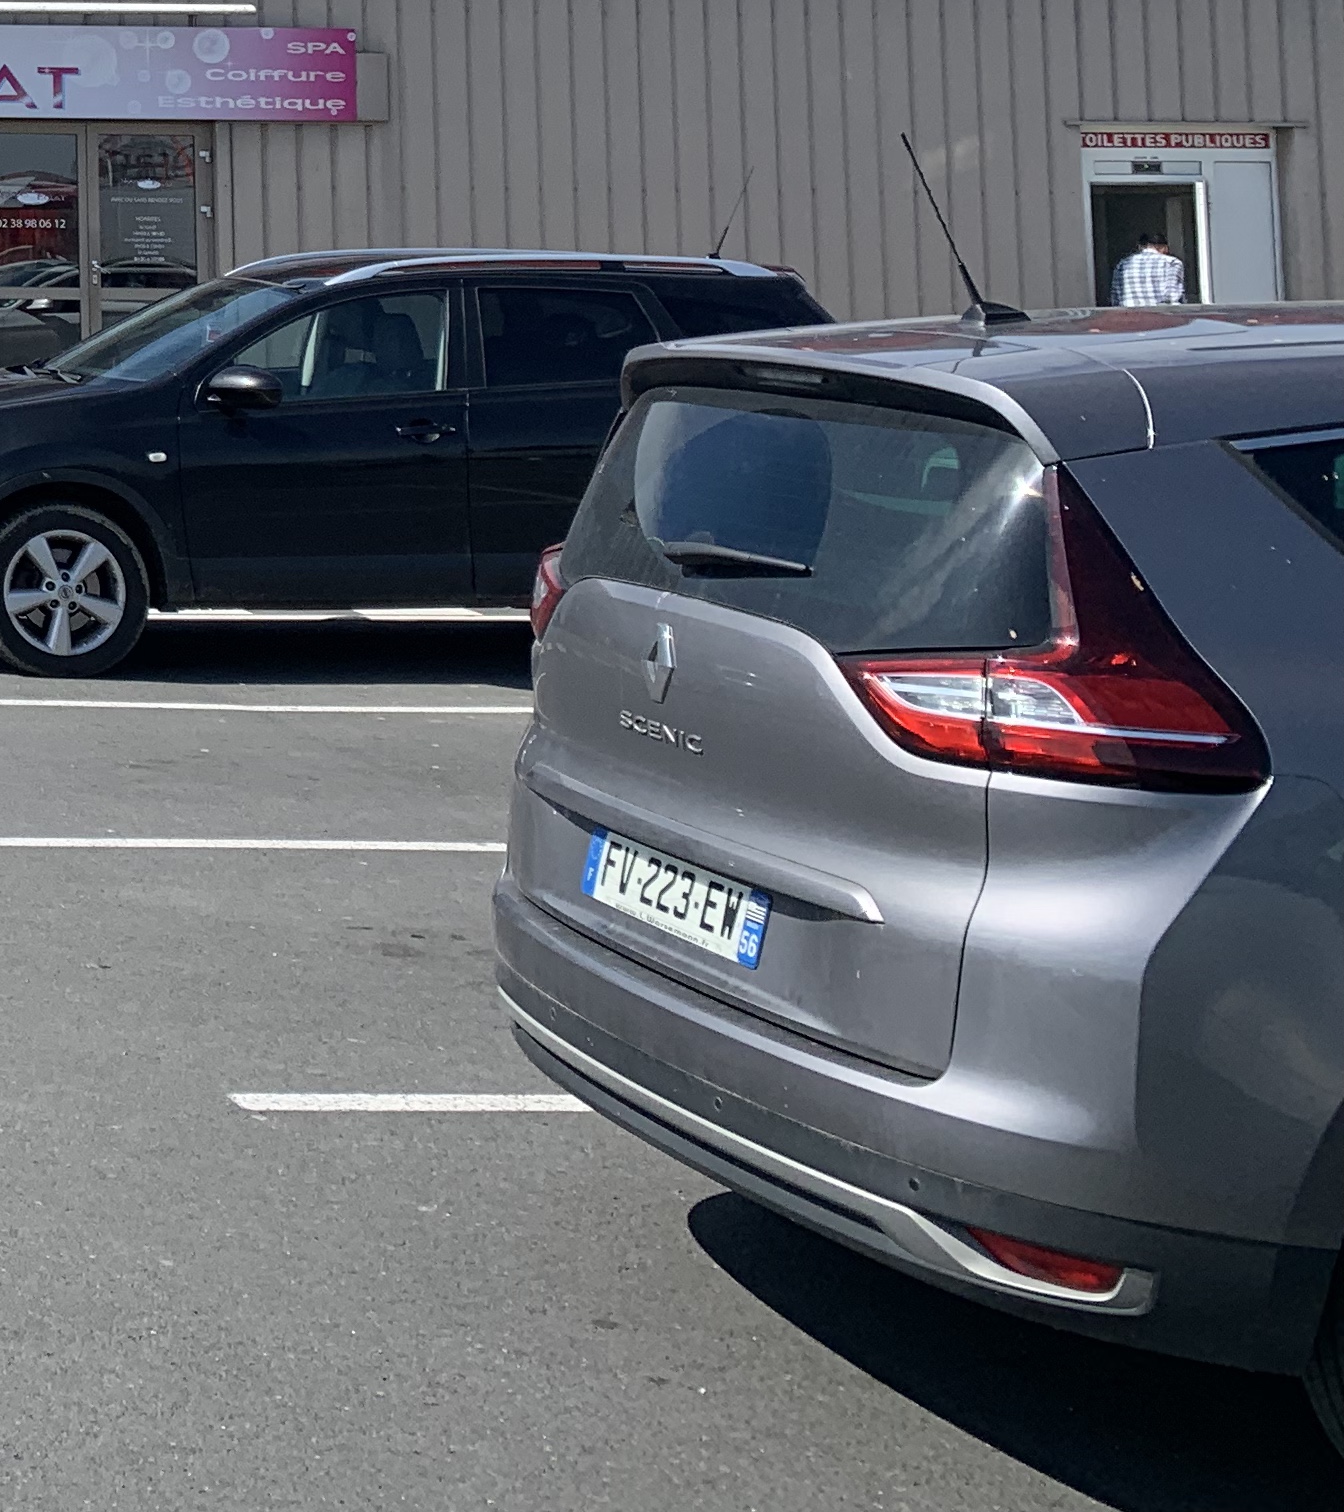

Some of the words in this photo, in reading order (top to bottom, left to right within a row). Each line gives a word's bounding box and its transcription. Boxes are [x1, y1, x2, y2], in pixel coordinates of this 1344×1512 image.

[286, 41, 347, 55] SPA
[205, 68, 347, 83] Coiffure
[157, 95, 348, 112] Esthétique
[1171, 134, 1266, 147] PUBLIQUES
[11, 218, 23, 229] 38
[25, 218, 37, 229] 98
[38, 218, 52, 229] 06
[55, 218, 66, 229] 12
[619, 709, 704, 756] SCENIC
[601, 840, 743, 940] FV-223-EW
[739, 930, 759, 957] 56
